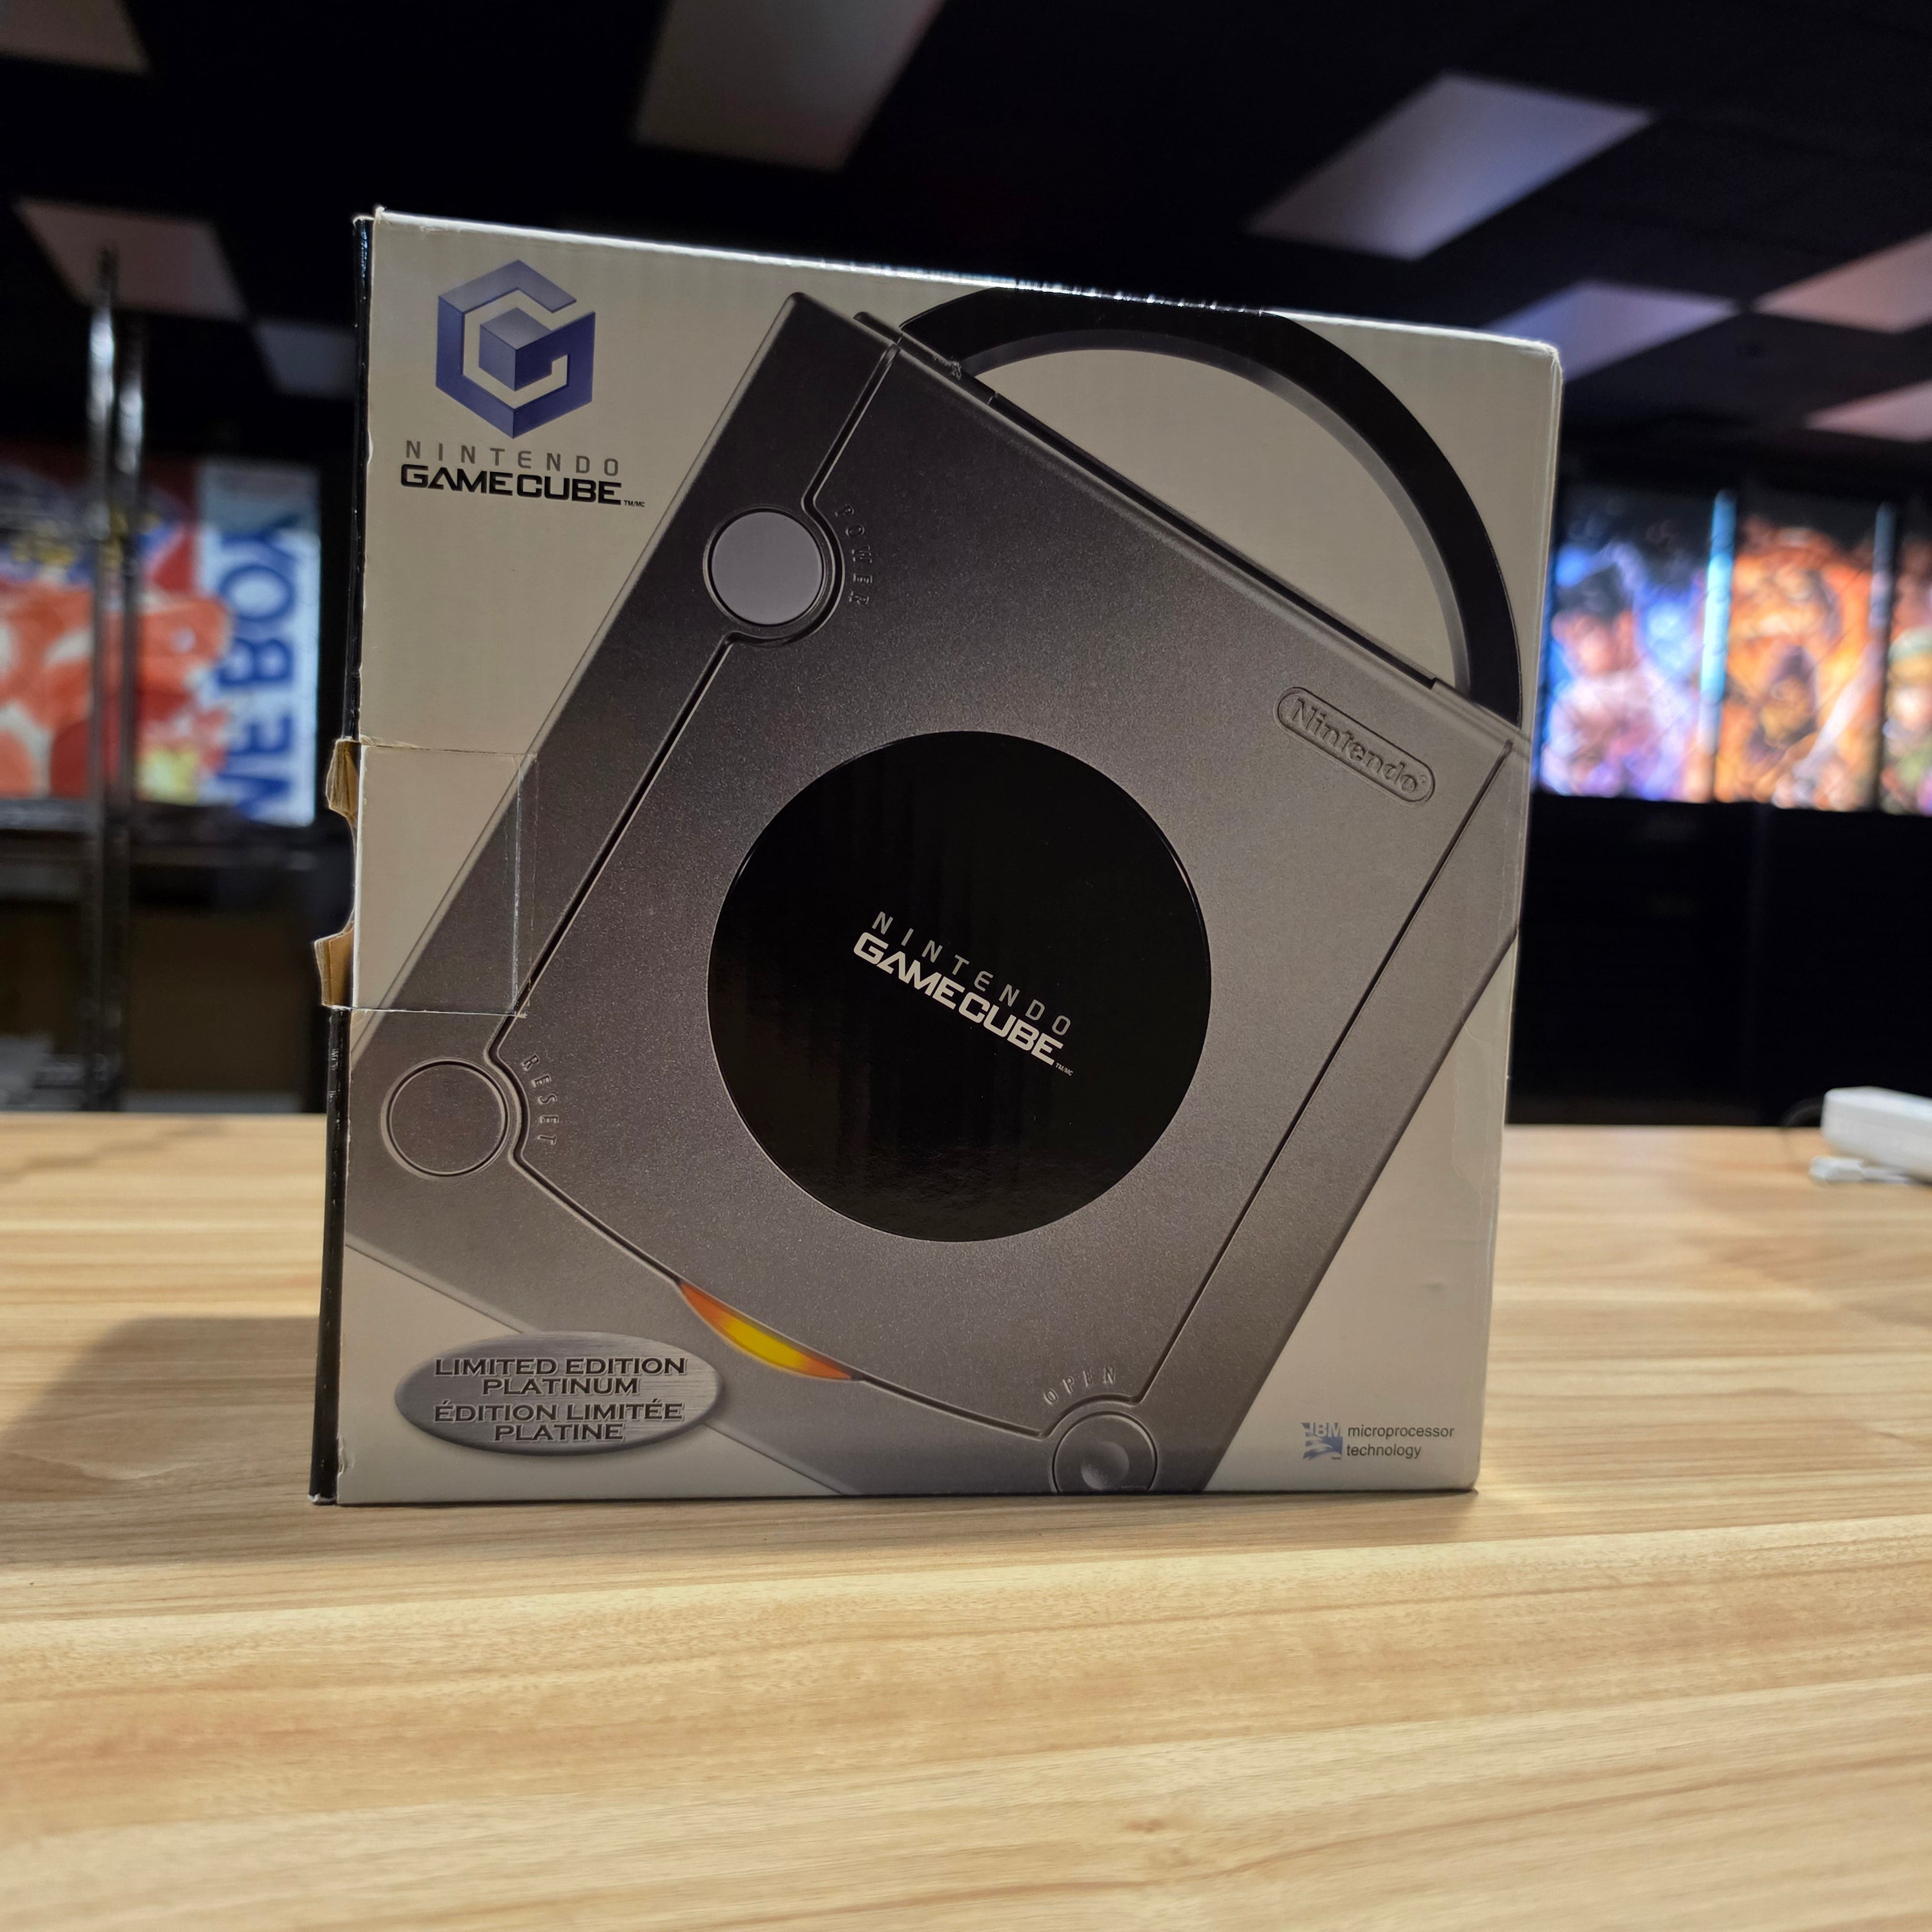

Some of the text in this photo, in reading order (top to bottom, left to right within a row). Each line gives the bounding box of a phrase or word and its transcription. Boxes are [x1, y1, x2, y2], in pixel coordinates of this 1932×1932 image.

[406, 440, 619, 477] NINTENDO
[401, 464, 622, 506] GAMECUBE
[1291, 697, 1418, 794] Nintendo
[872, 911, 1071, 1036] NINTENDO
[854, 932, 1064, 1065] GAMECUBE
[521, 1053, 560, 1146] RESET
[435, 1357, 686, 1376] LIMITED EDITION
[482, 1377, 639, 1395] PLATINUM
[1043, 1366, 1116, 1405] OPEN
[434, 1397, 683, 1422] ÉDITION LIMITÉE
[494, 1423, 624, 1441] PLATINE
[1347, 1424, 1455, 1439] microprocessor
[1346, 1444, 1422, 1459] technology
